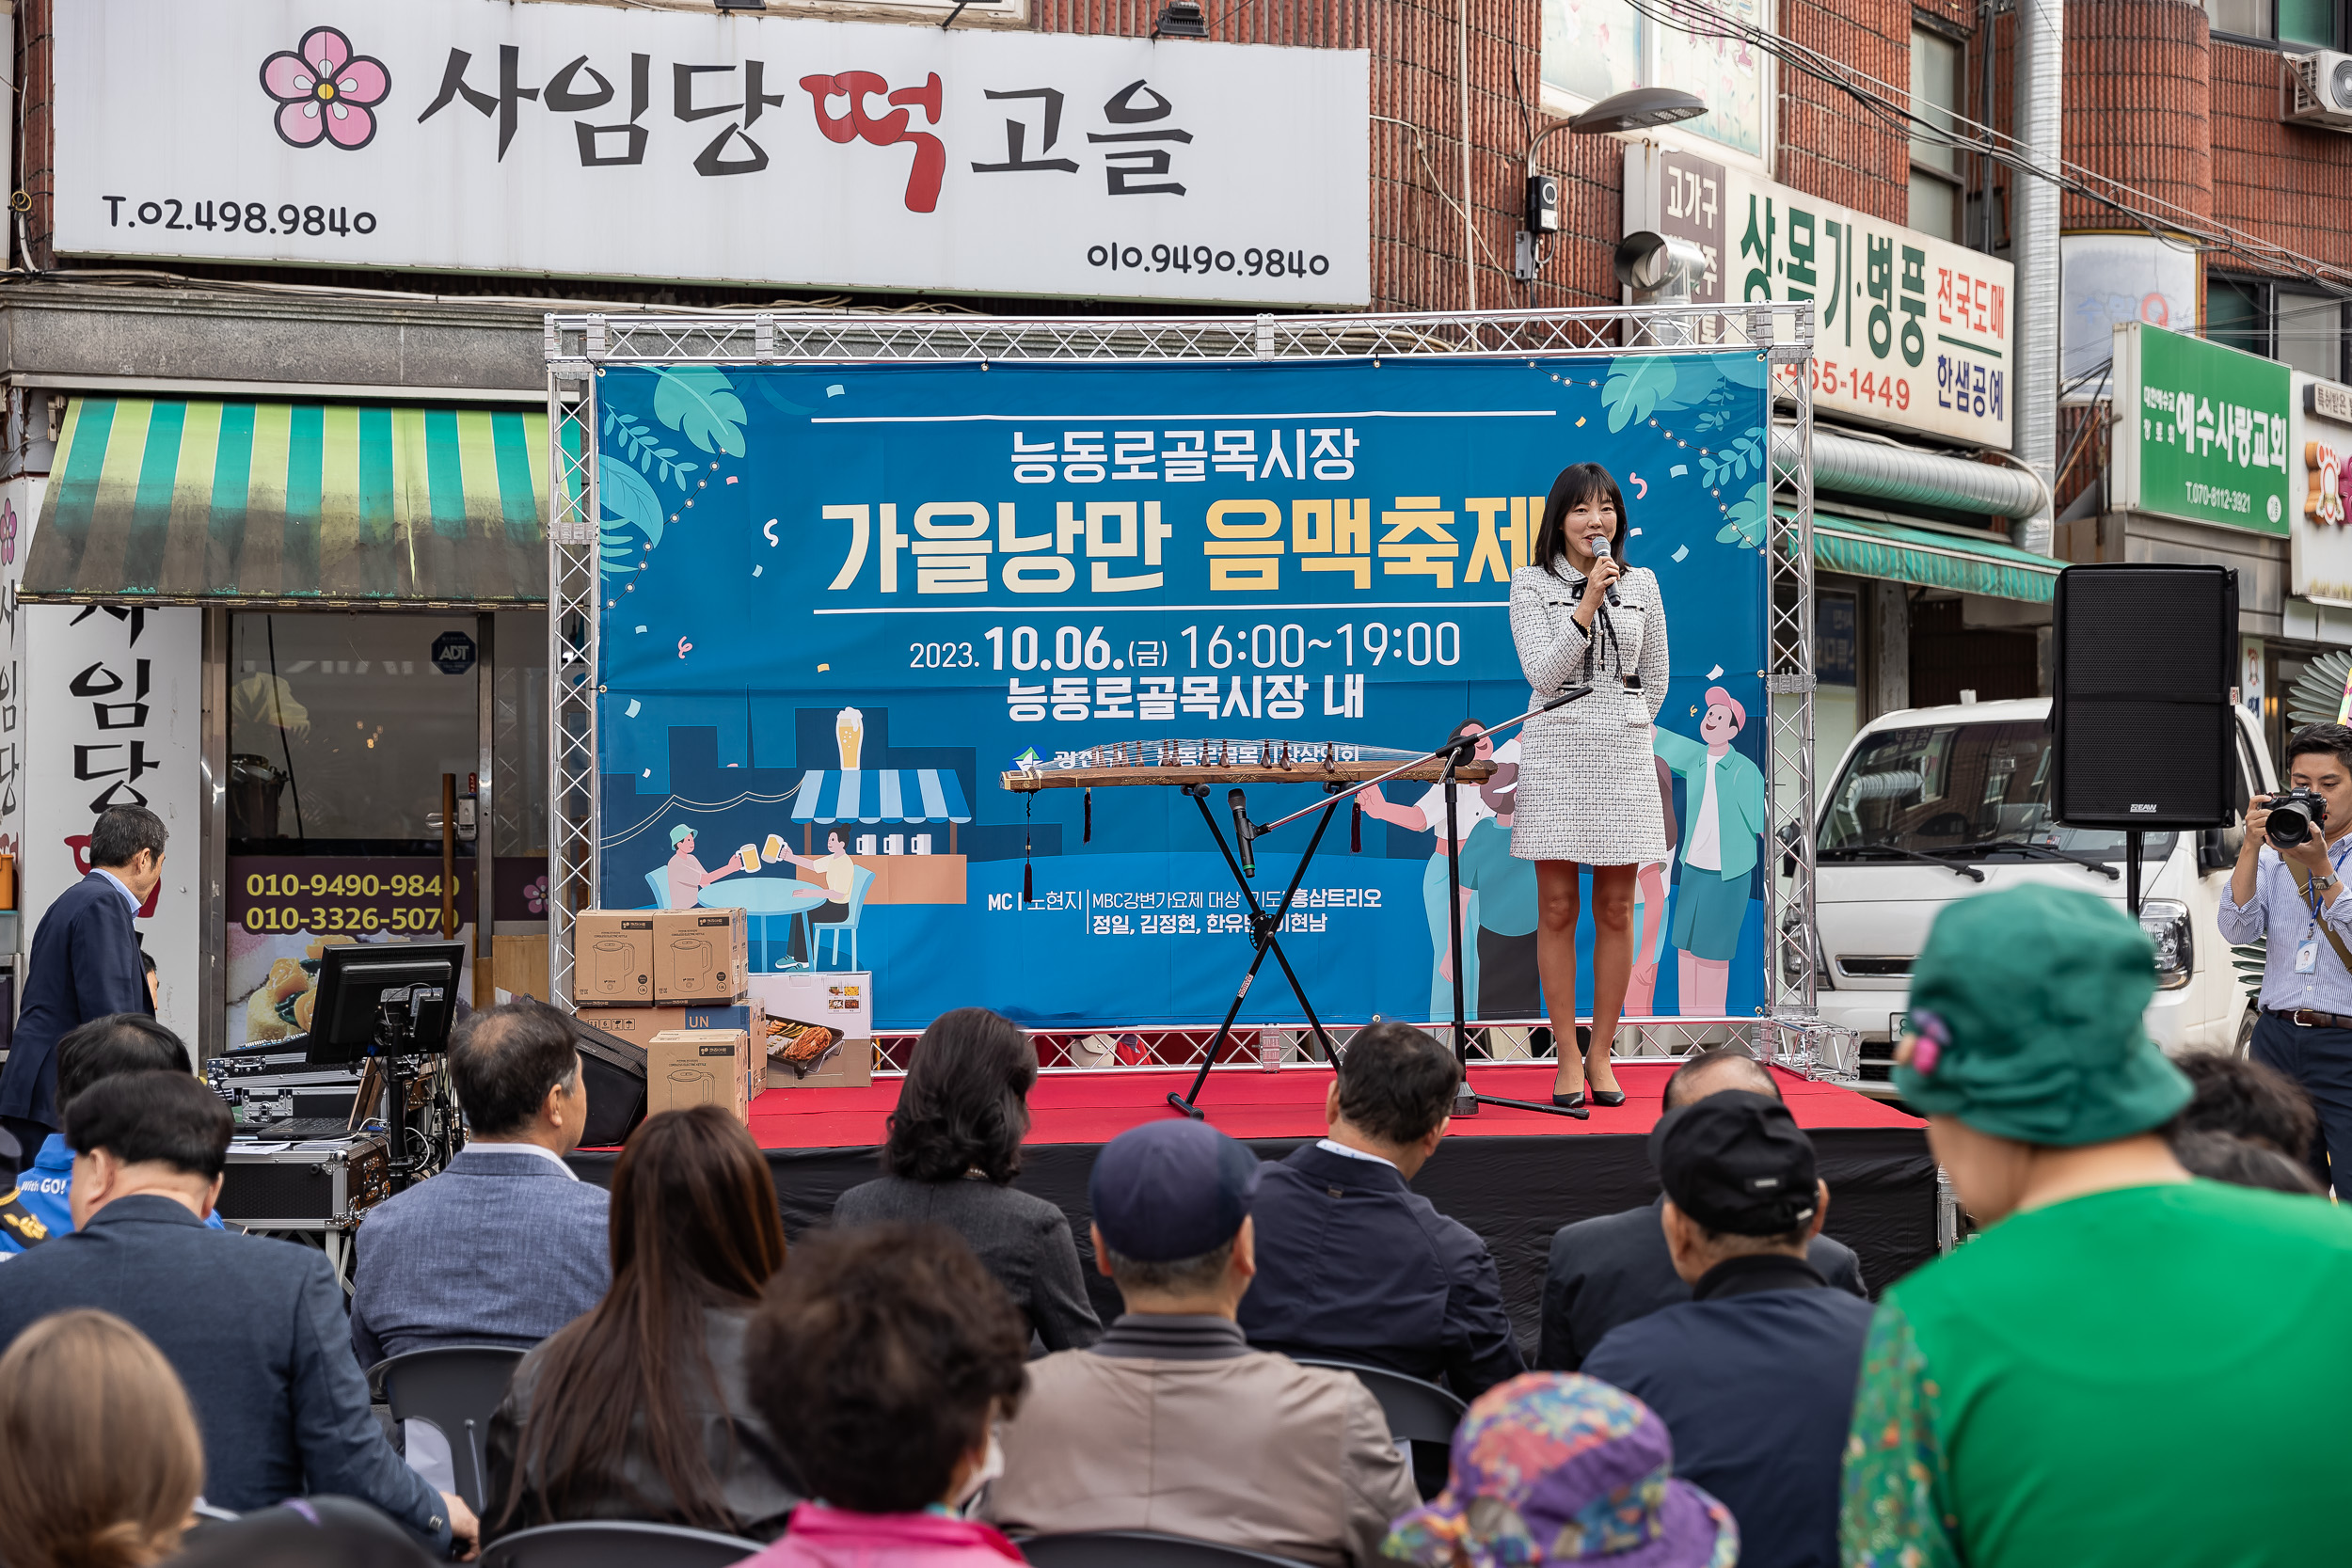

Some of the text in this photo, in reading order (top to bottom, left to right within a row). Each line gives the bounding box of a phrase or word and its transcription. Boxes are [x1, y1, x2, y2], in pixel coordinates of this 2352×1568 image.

[102, 196, 376, 237] T.02.498.9840
[1667, 166, 1718, 230] 고가구
[1088, 244, 1329, 277] 010.9490.9840
[1938, 267, 2004, 340] 전국도매
[1938, 355, 2004, 421] 한샘공예
[1010, 428, 1360, 484] 능동로골목시장
[2175, 390, 2286, 475] 예수사랑교회
[821, 496, 1546, 594] 가을낭만 음맥축제
[439, 645, 469, 660] ADT
[1182, 621, 1460, 670] 16:00~19:00
[1007, 673, 1364, 722] 능동로골목시장 내
[988, 893, 1013, 911] MC
[1092, 891, 1203, 910] MBC강변가요제
[1208, 891, 1241, 909] 대상
[1292, 888, 1382, 909] 홍삼트리오
[1093, 914, 1135, 935] 정일,
[1140, 914, 1201, 935] 김정현,
[689, 1016, 709, 1028] UN
[21, 1178, 67, 1195] With GO!
